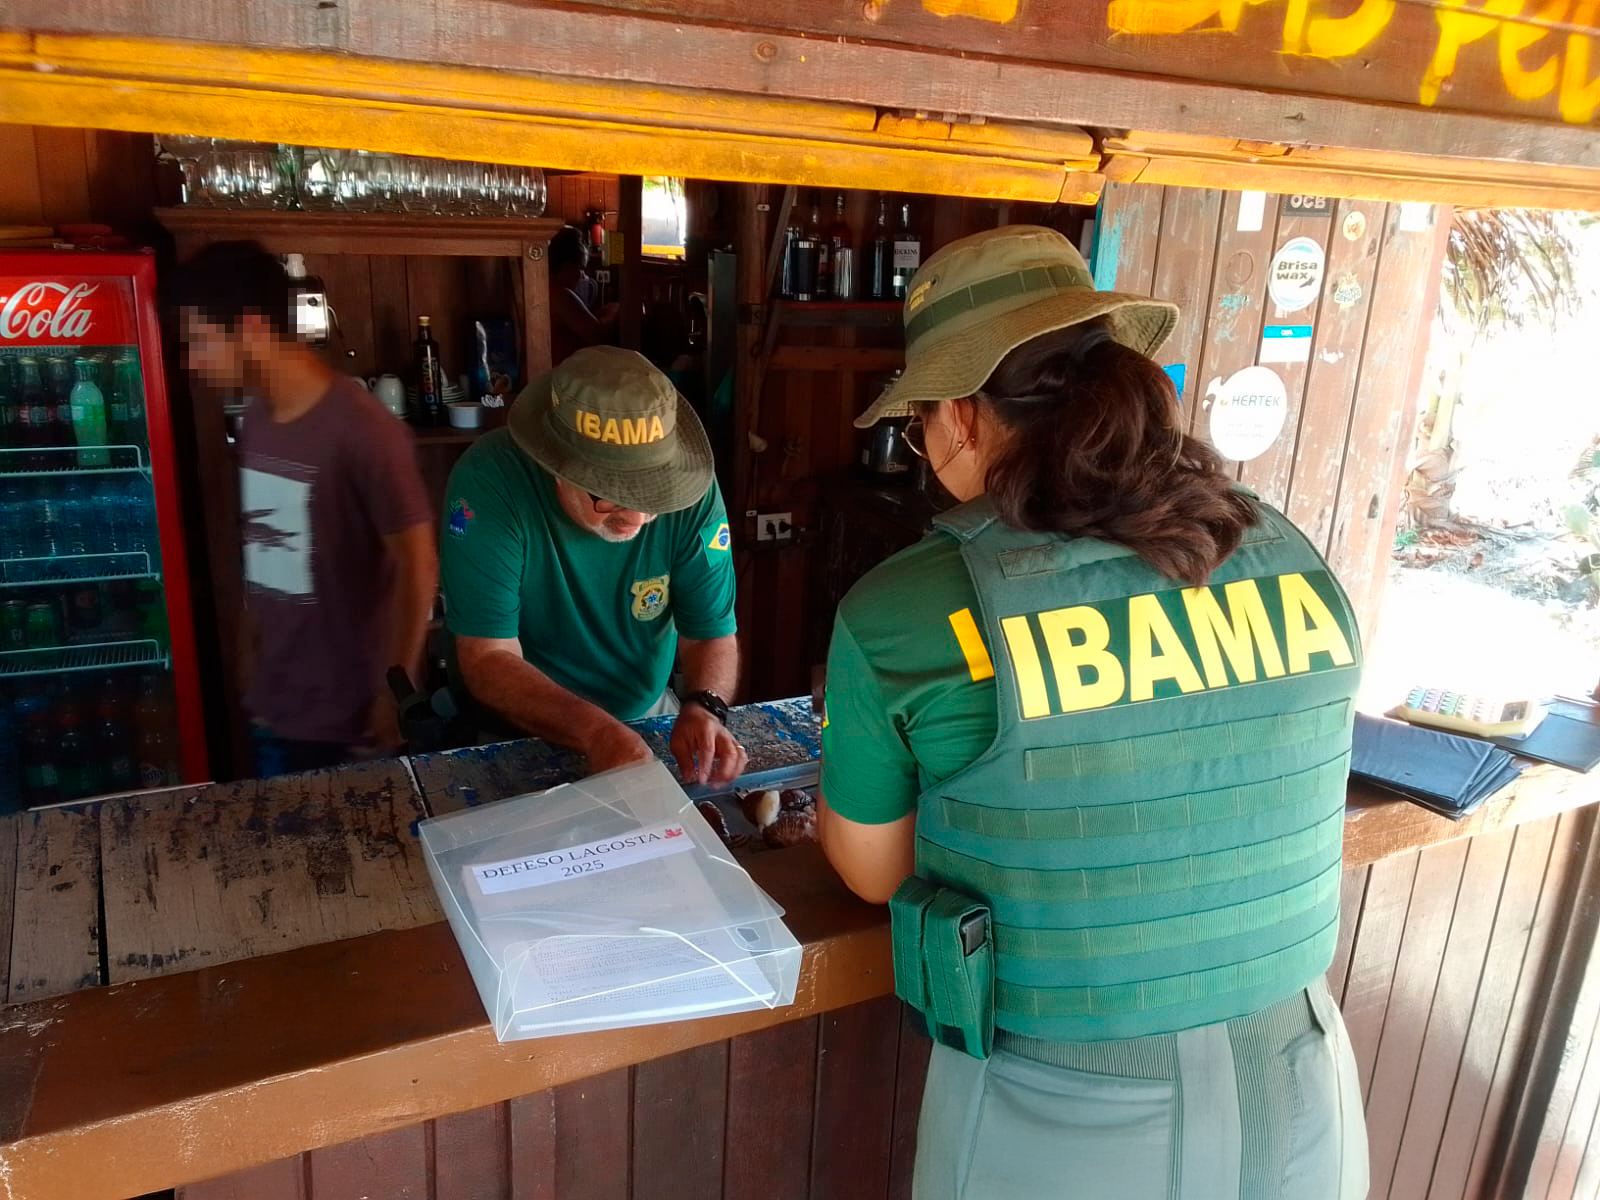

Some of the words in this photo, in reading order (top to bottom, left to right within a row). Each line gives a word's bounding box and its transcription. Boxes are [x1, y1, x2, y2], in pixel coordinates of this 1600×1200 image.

[1290, 194, 1326, 209] OCB
[1278, 260, 1317, 271] Brisa
[1277, 272, 1308, 280] wax
[575, 409, 665, 445] IBAMA
[1000, 572, 1356, 719] IBAMA
[482, 854, 564, 879] DEFESO
[568, 832, 662, 862] LAGOSTA
[561, 859, 605, 877] 2025
